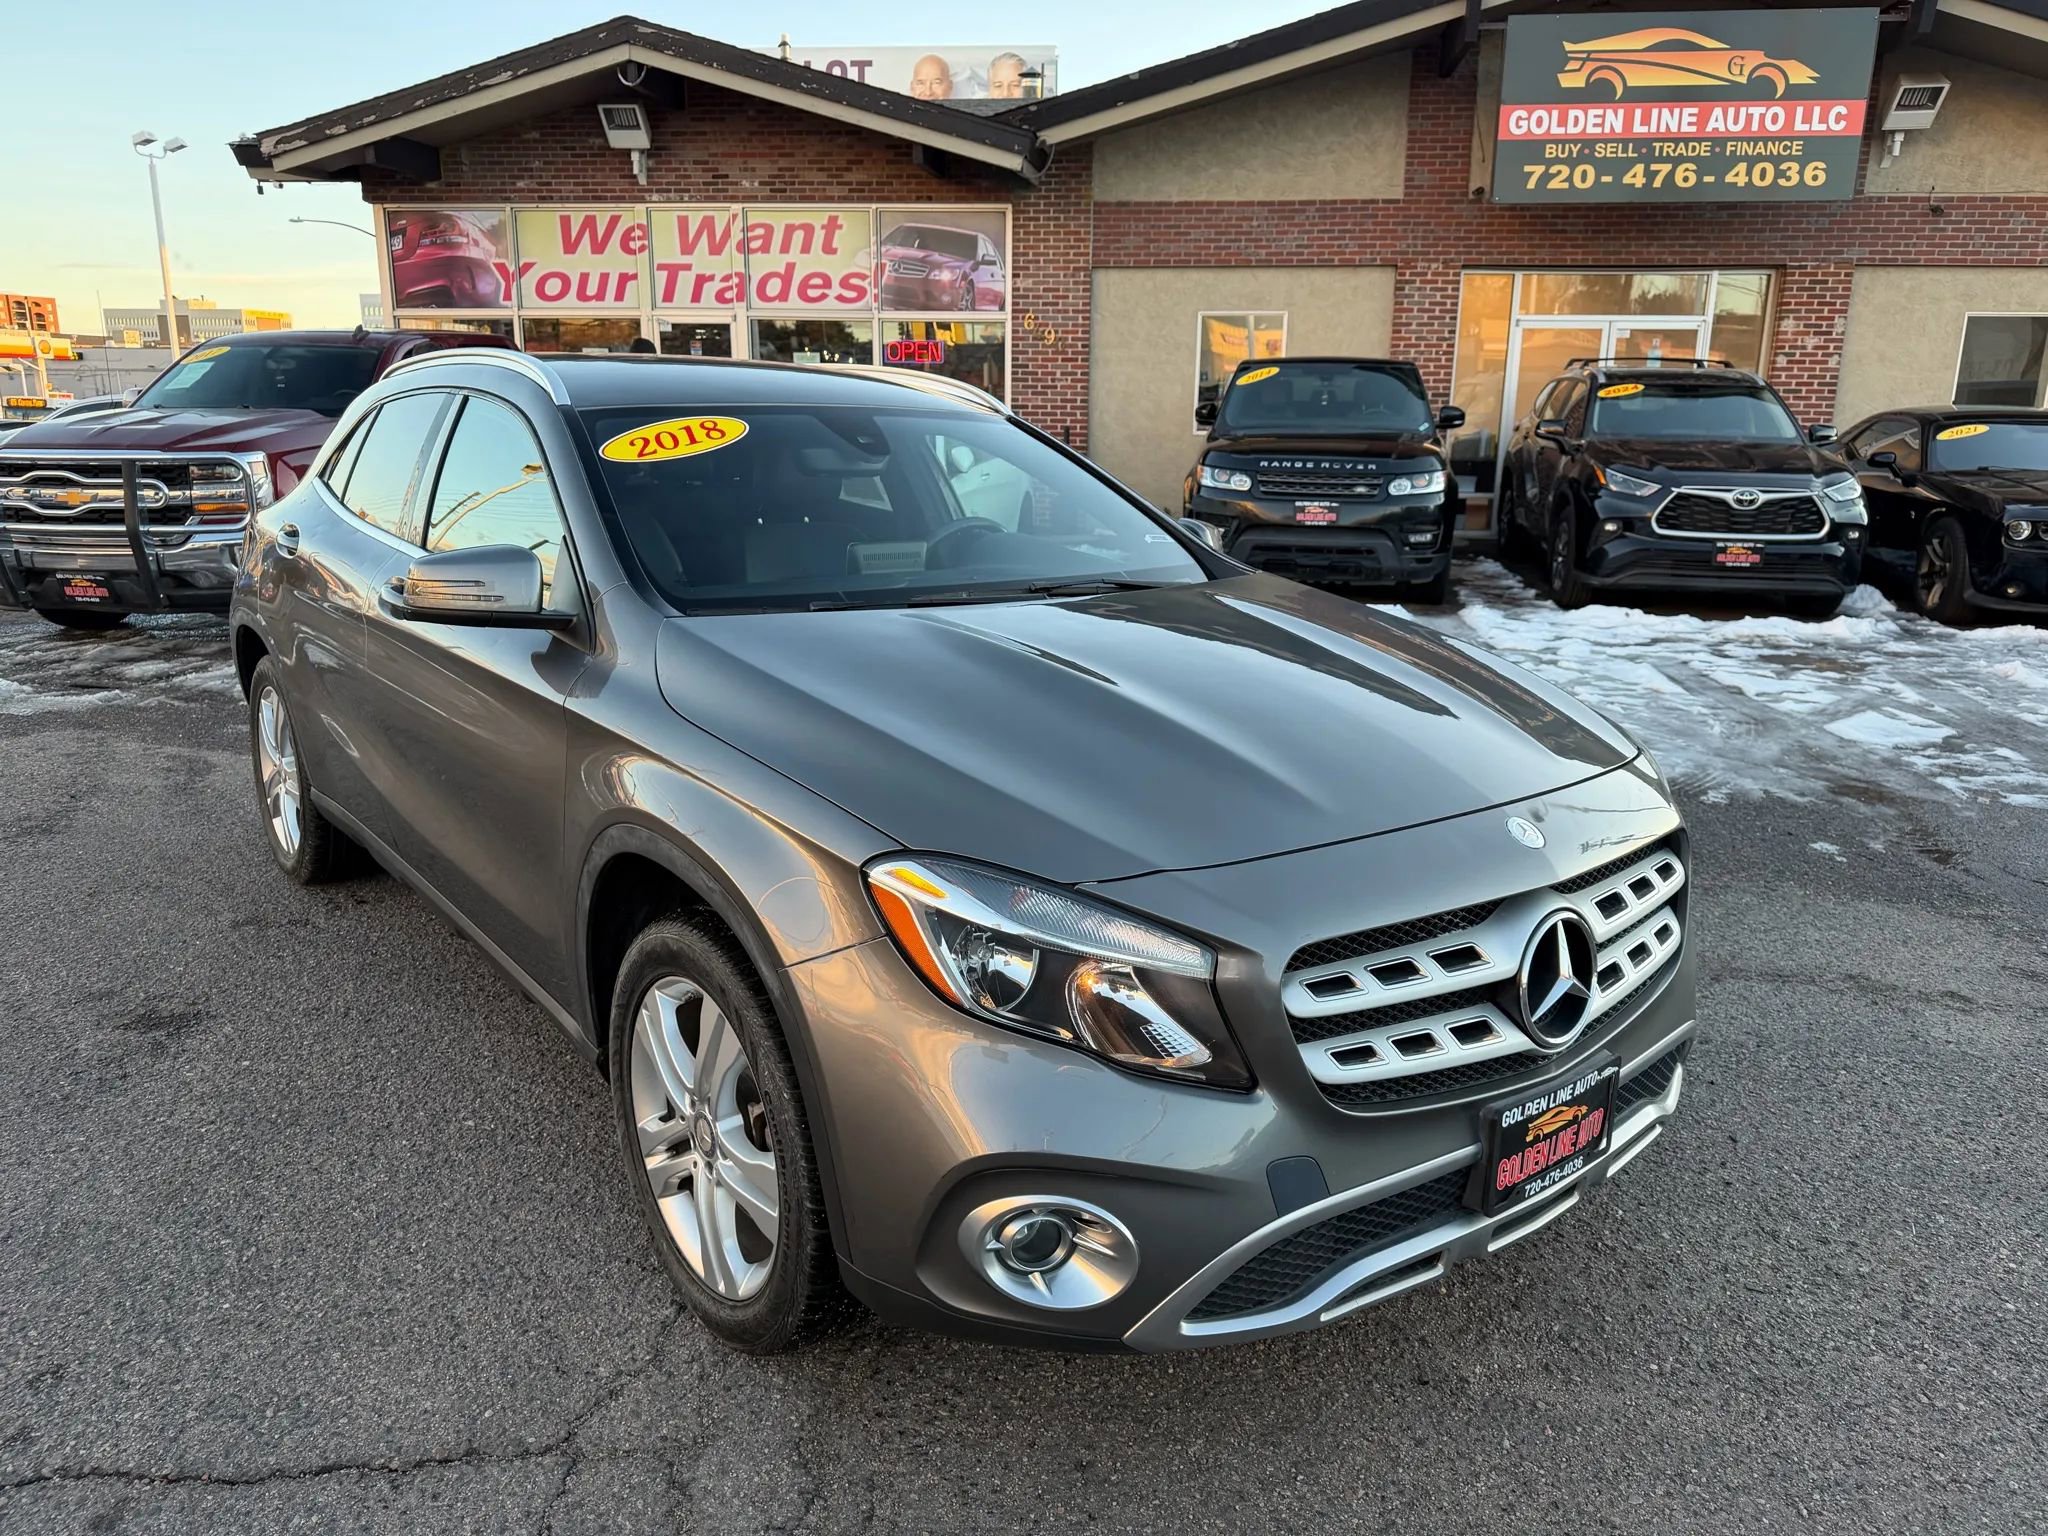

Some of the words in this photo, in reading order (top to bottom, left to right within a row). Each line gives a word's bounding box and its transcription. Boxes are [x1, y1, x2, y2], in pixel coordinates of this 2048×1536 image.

[1509, 109, 1624, 136] GOLDEN
[1632, 107, 1698, 134] LINE
[1705, 105, 1785, 133] AUTO
[1793, 104, 1847, 132] LLC
[1545, 143, 1582, 158] BUY
[1594, 142, 1638, 158] SELL
[1652, 142, 1711, 157] TRADE
[1726, 141, 1804, 156] FINANCE
[559, 213, 649, 256] We
[676, 213, 843, 257] Want
[492, 261, 639, 303] Your
[656, 261, 887, 304] Trades!
[887, 341, 942, 363] OPEN
[1604, 384, 1639, 396] 2024
[629, 420, 726, 458] 2018
[1948, 426, 1978, 438] 2021
[1321, 462, 1377, 470] ROVER
[1502, 1096, 1547, 1128] GOLDEN
[1549, 1083, 1574, 1107] LINE
[1573, 1070, 1599, 1097] AUTO
[1496, 1141, 1552, 1191] GOLDEN
[1549, 1124, 1577, 1166] LINE
[1576, 1107, 1605, 1151] AUTO
[1524, 1155, 1584, 1198] 720-476-4036
